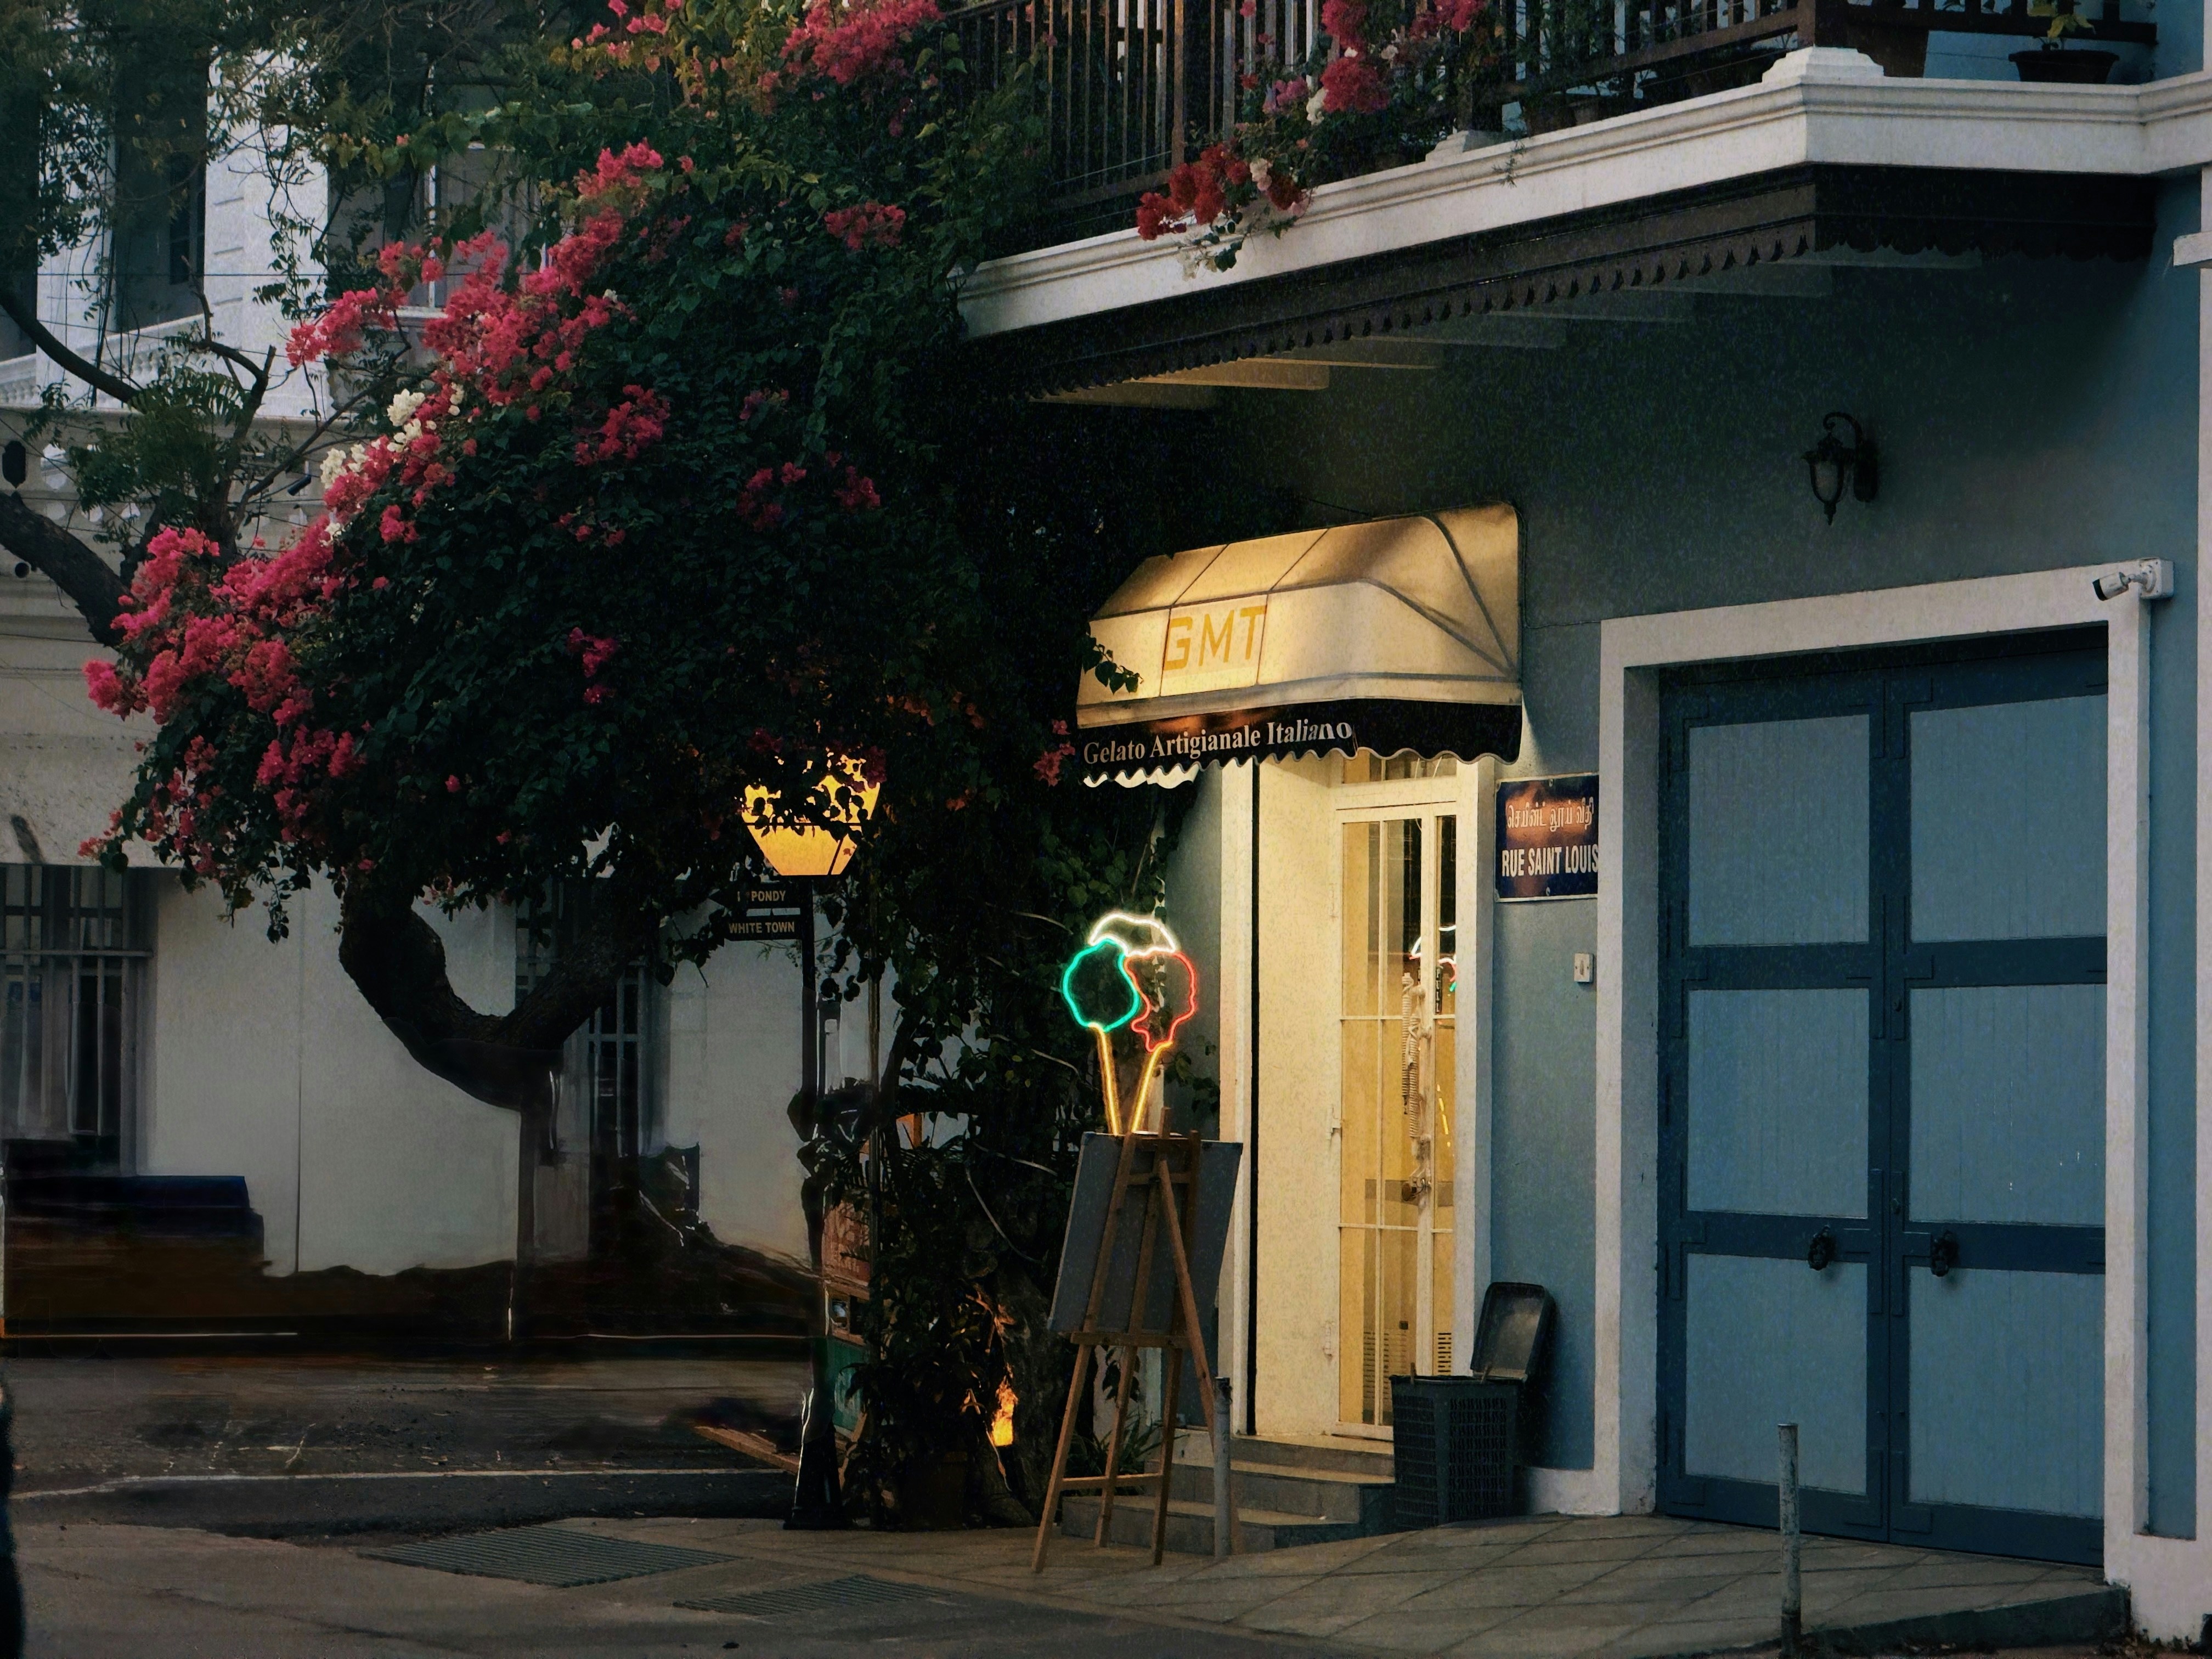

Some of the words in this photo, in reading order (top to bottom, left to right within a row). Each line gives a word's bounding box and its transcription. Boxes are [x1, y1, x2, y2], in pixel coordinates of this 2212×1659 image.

[1163, 605, 1267, 670] GMT
[1084, 741, 1145, 764] Gelato
[1149, 725, 1261, 759] Artigianale
[1267, 719, 1352, 745] Italiano
[1502, 849, 1525, 877] RUE
[1528, 847, 1562, 876] SAINT
[1565, 843, 1598, 874] LOUIS
[751, 890, 786, 901] PONDY
[729, 922, 763, 934] WHITE
[765, 922, 795, 933] TOWN
